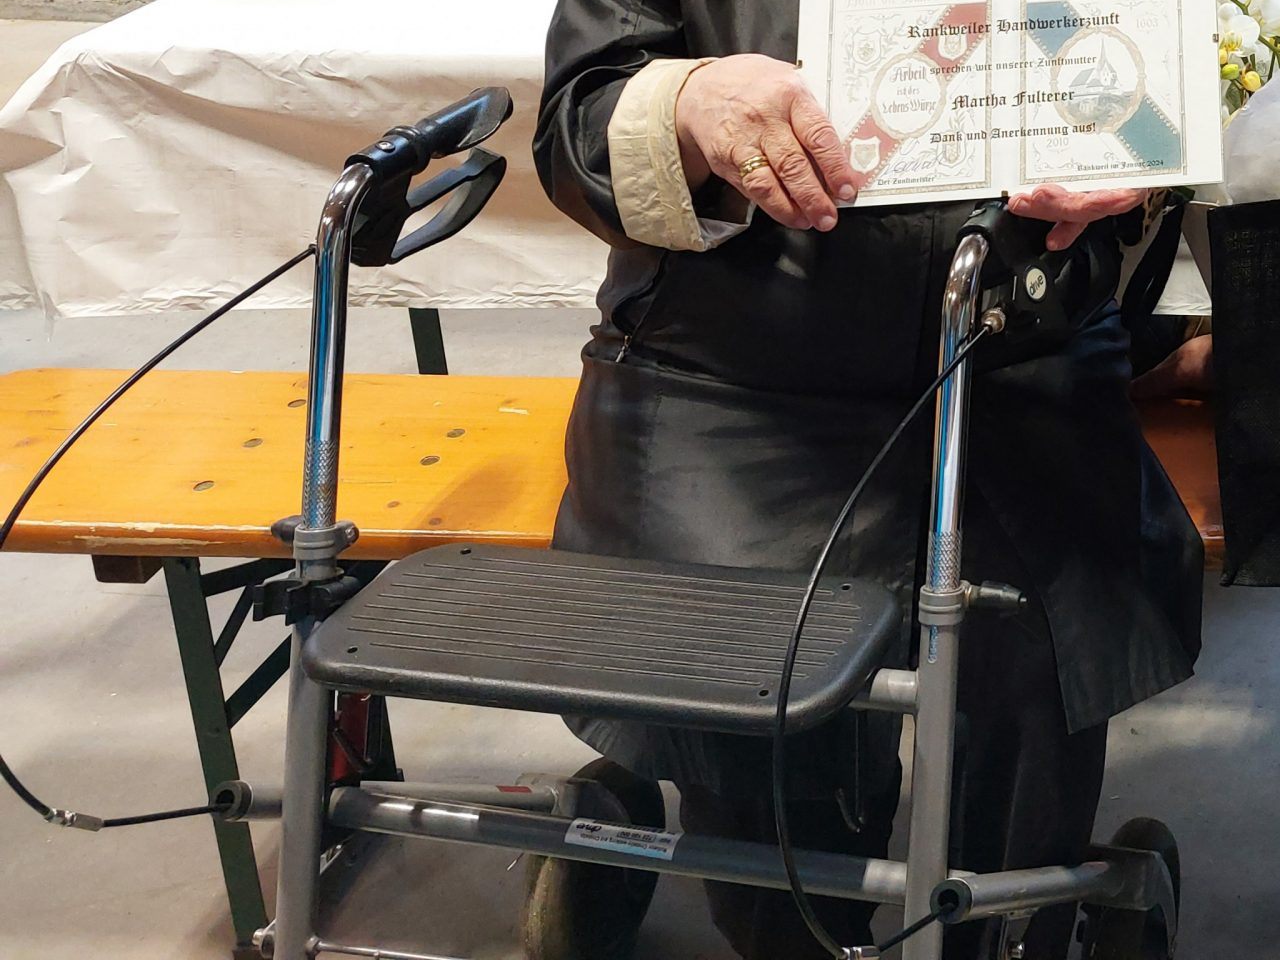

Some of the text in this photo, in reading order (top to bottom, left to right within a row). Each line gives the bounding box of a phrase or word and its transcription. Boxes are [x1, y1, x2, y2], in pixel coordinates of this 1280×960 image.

[907, 12, 1120, 38] Rankweiler Handwerkerzunft
[930, 56, 1097, 76] sprechen wir unserer Zunftmutter
[952, 90, 1075, 110] Martha Fulterer
[930, 122, 1096, 144] Dank und Anerkennung aus!
[1147, 159, 1164, 167] 2024
